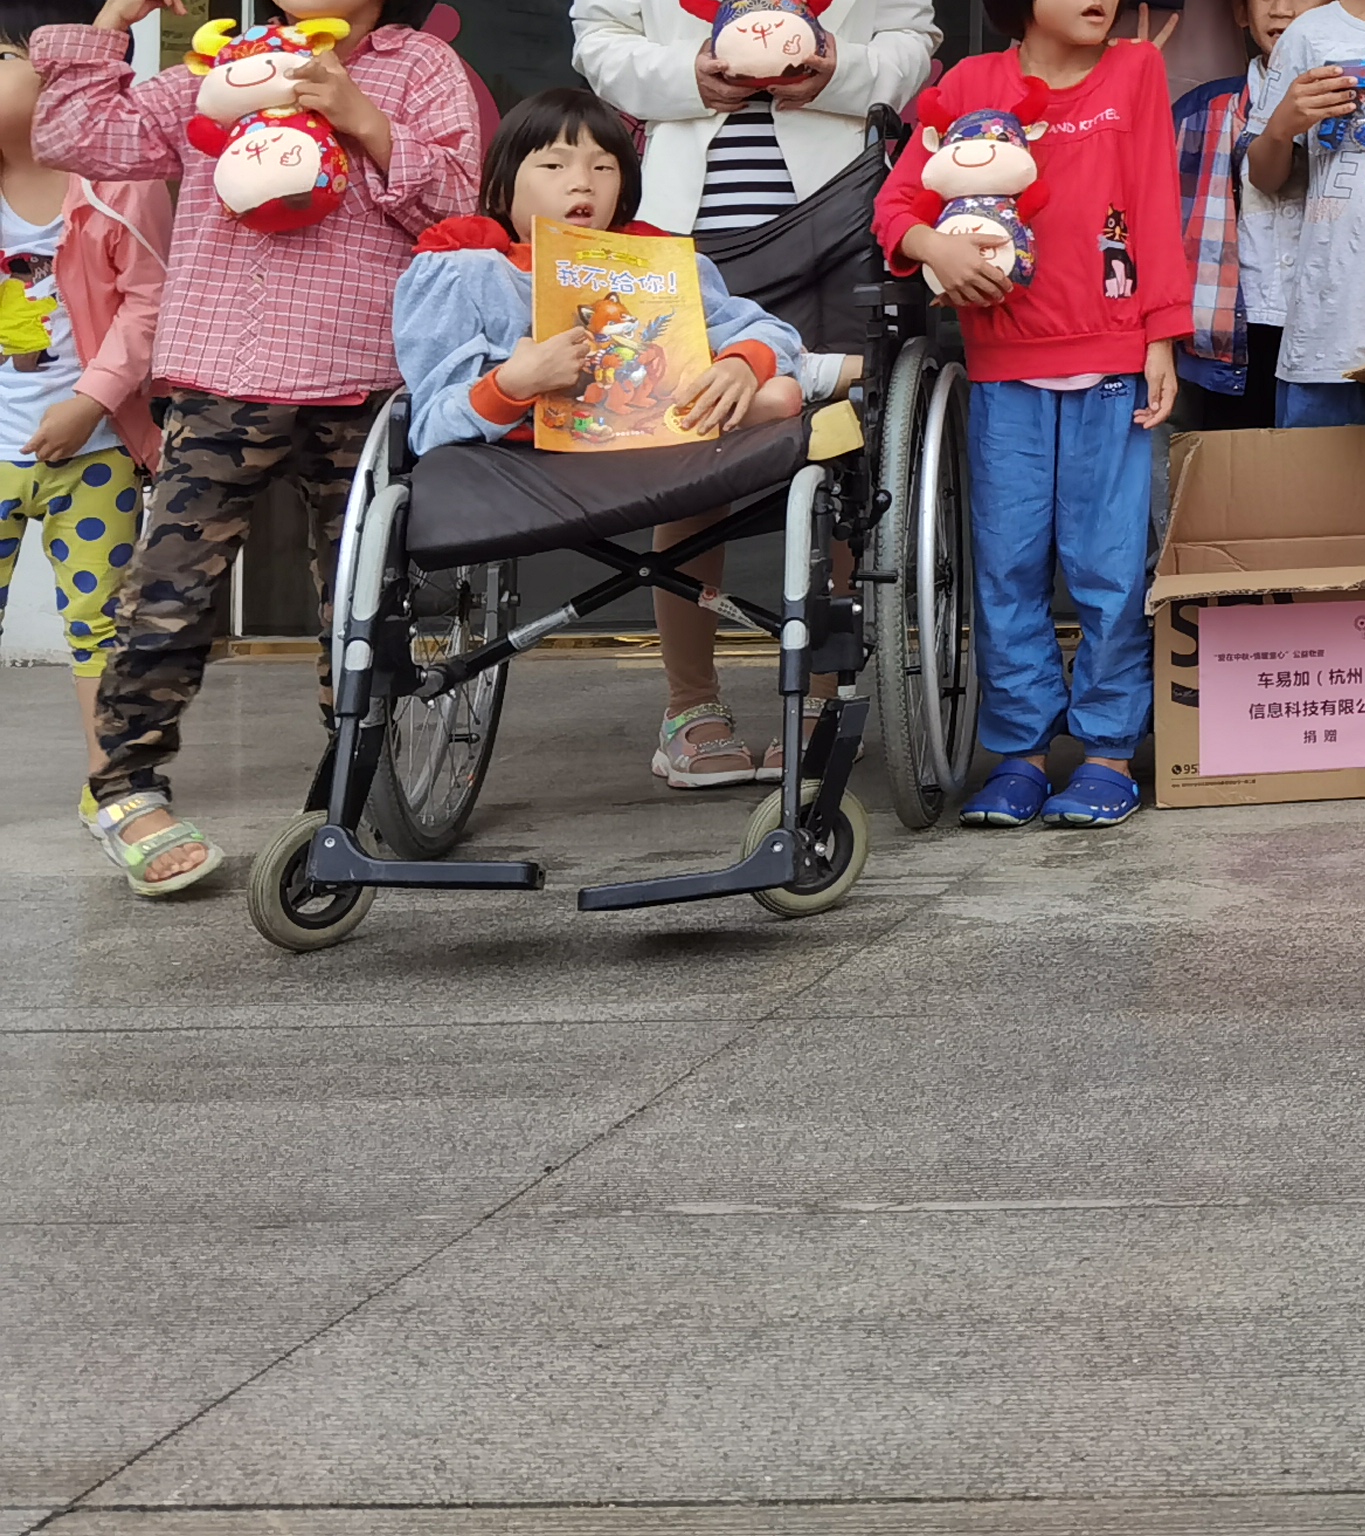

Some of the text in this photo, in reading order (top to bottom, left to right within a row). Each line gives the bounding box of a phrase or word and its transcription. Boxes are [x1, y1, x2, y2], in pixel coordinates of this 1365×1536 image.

[555, 260, 678, 295] 我不给你！
[1303, 729, 1338, 744] 捐赠
